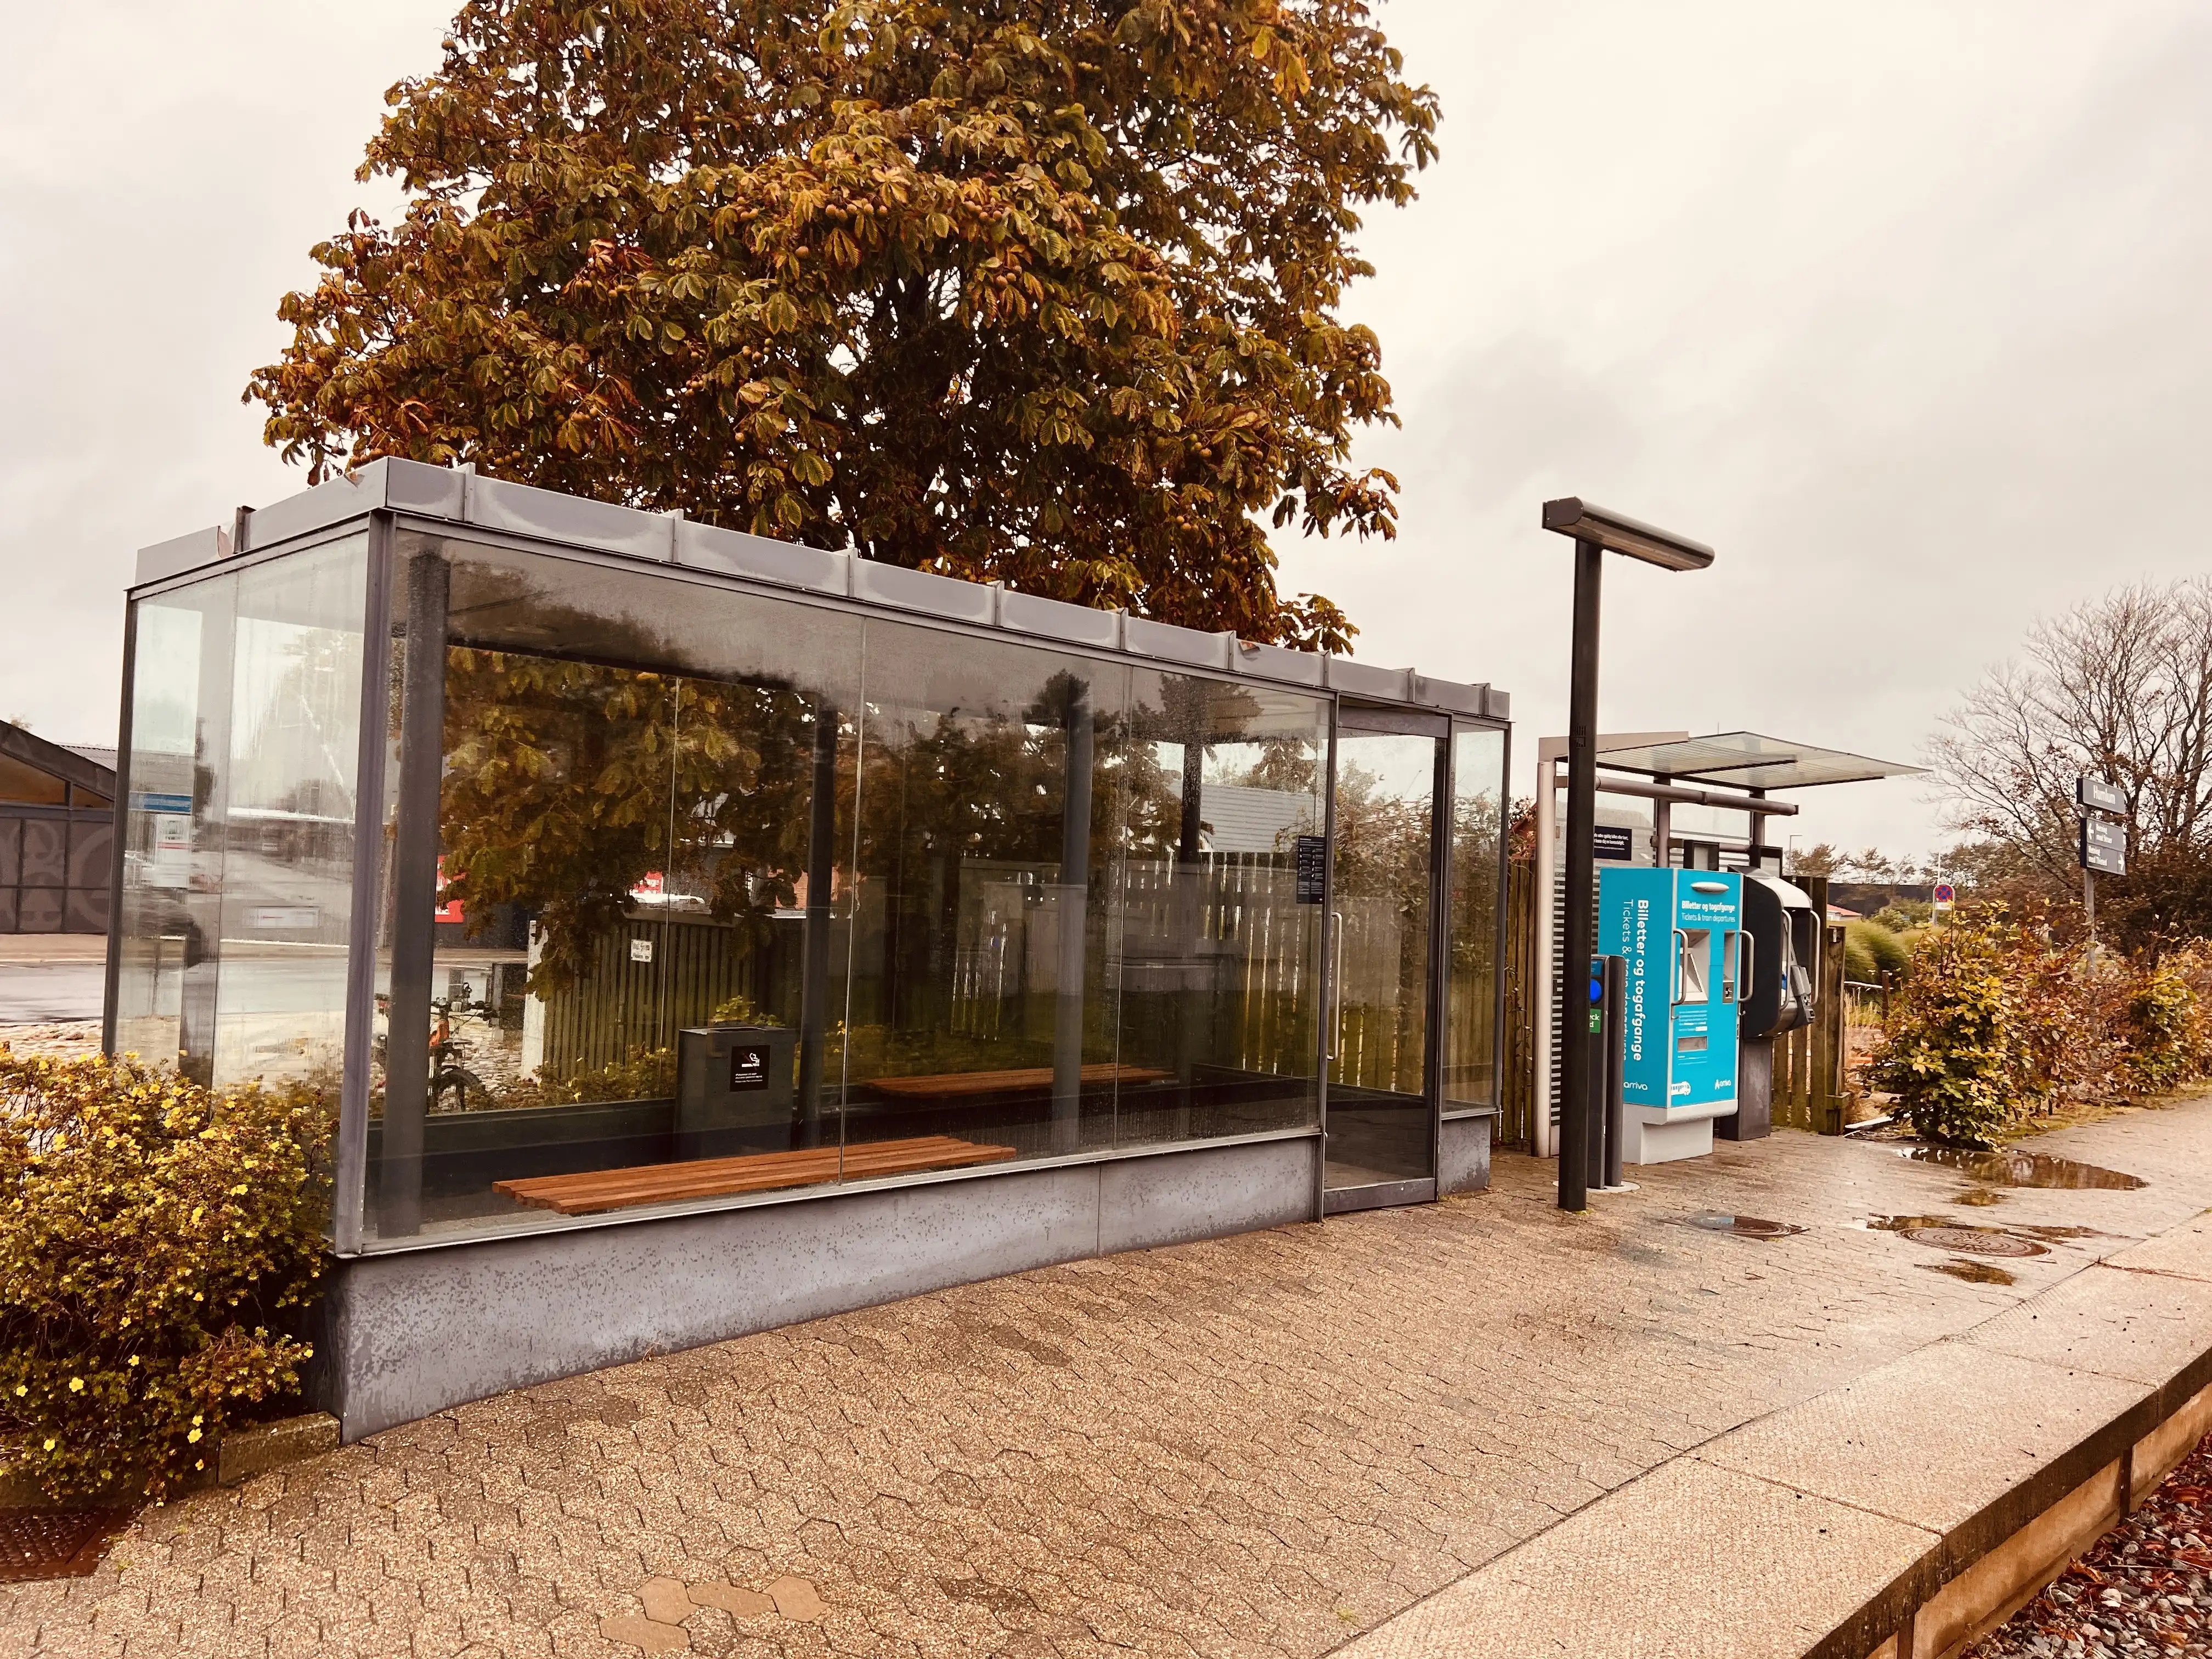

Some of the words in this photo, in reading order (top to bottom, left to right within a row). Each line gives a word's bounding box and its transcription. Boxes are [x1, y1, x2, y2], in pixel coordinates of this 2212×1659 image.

[1681, 900, 1701, 909] Billetter
[1622, 899, 1634, 943] Tickets
[1681, 912, 1697, 921] Tickets
[1637, 900, 1649, 956] Billetter
[1622, 946, 1632, 954] &
[1633, 959, 1644, 976] og
[1631, 980, 1646, 1061] togafgange
[1623, 1082, 1648, 1090] arriva
